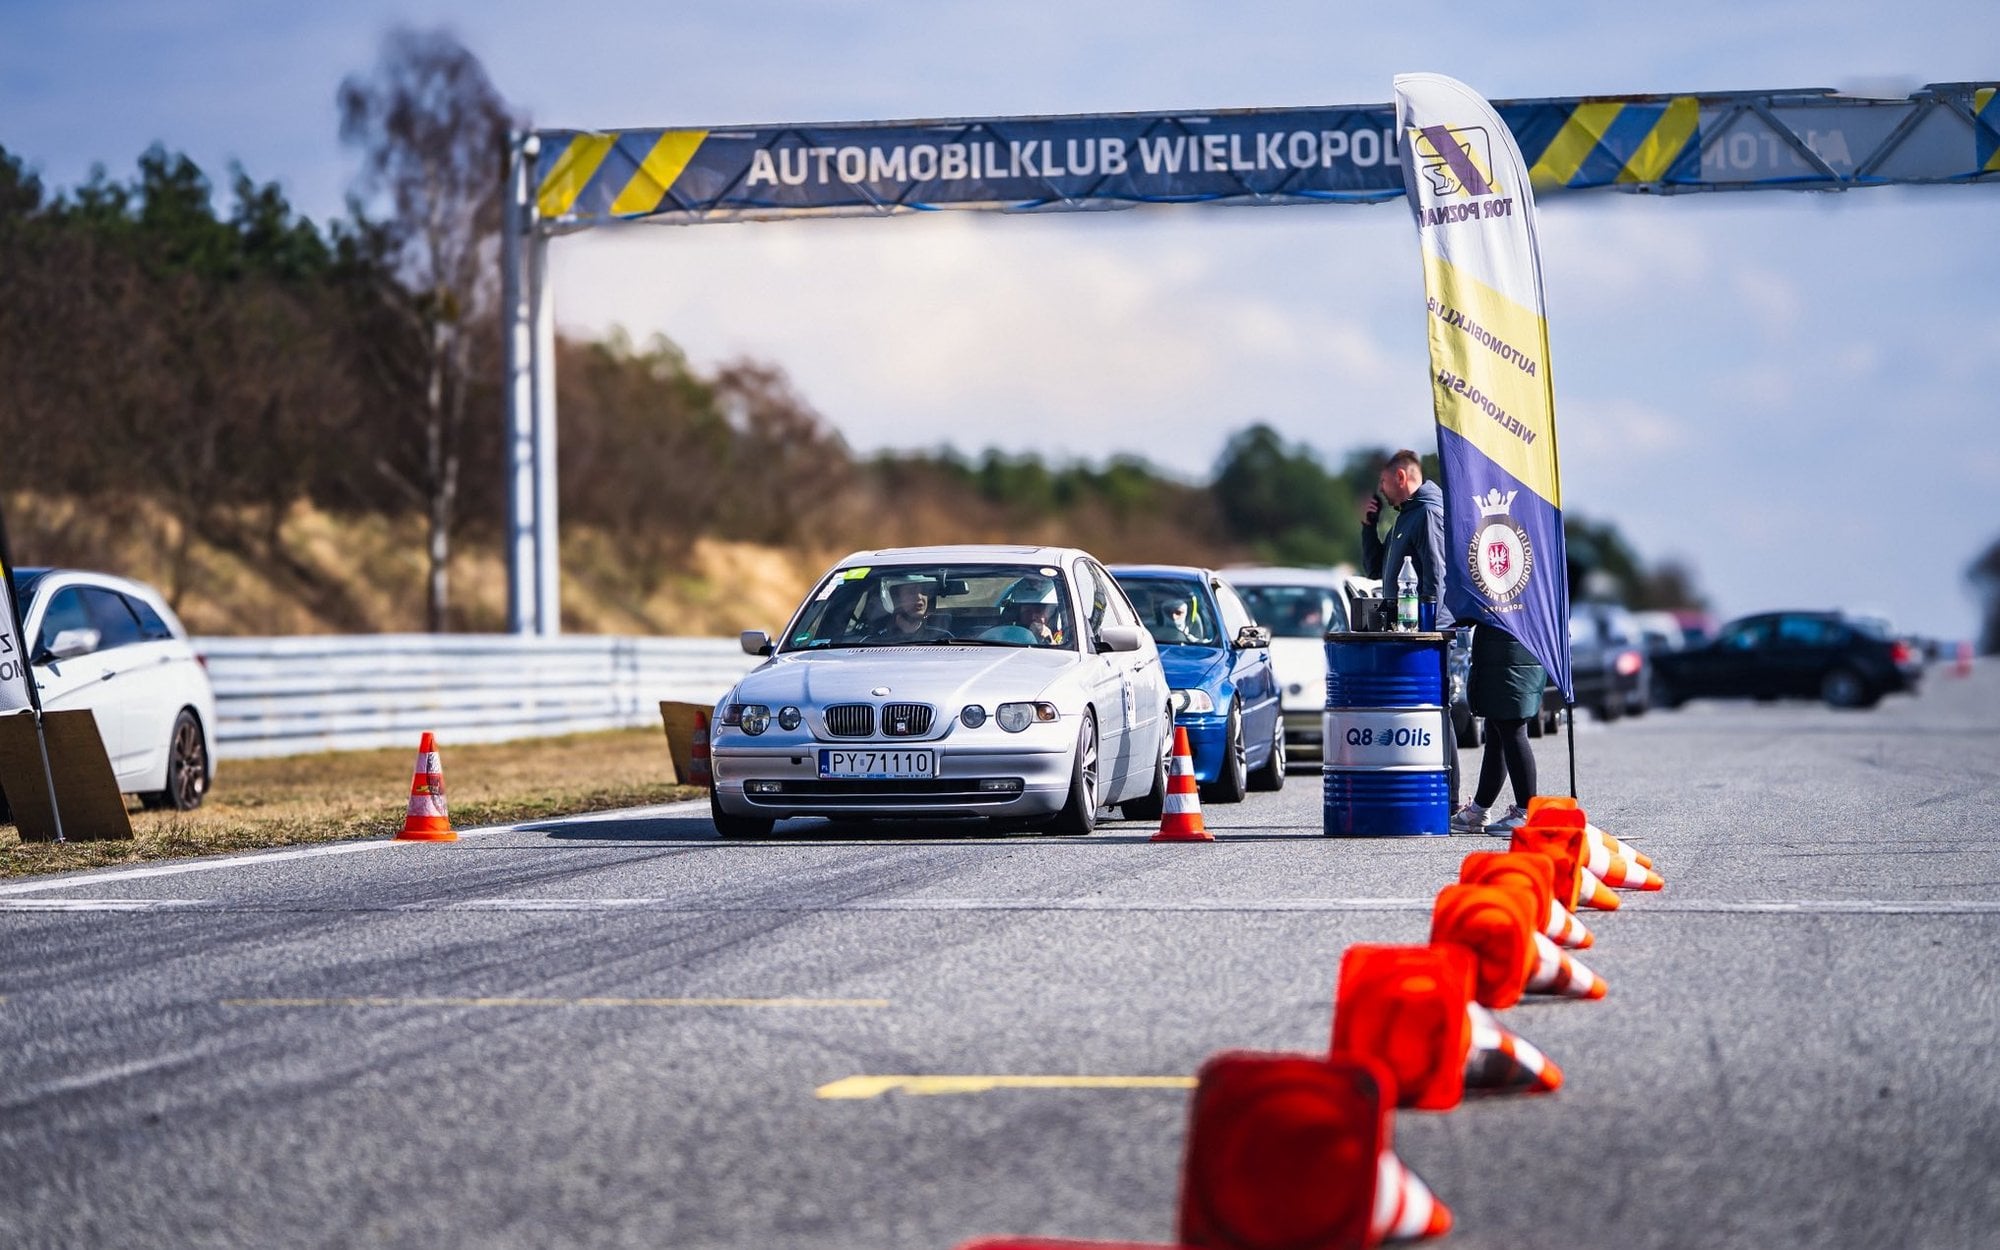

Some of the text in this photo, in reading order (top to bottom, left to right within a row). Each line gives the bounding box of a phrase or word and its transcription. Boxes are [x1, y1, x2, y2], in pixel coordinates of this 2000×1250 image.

[746, 137, 1126, 187] AUTOMOBILKLUB
[1346, 727, 1431, 747] Q8 Oils
[833, 753, 927, 773] PY 71110
